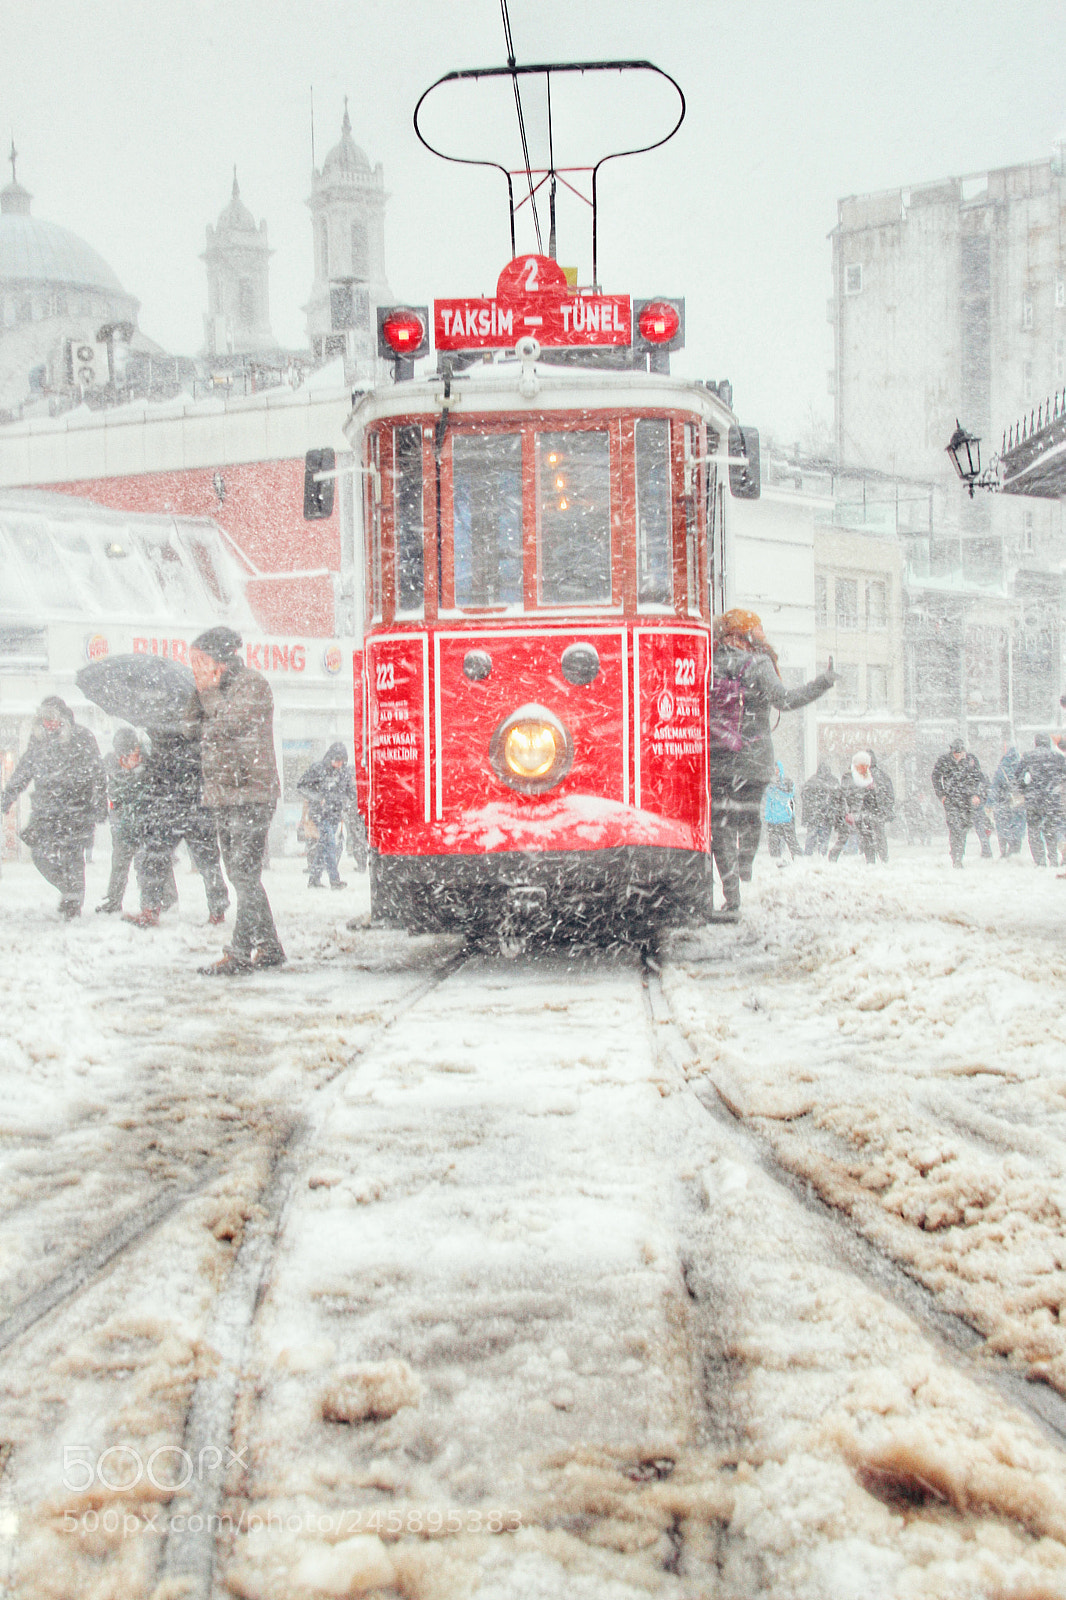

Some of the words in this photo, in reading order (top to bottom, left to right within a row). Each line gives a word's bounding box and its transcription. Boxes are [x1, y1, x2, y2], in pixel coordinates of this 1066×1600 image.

[525, 258, 539, 291] 2
[441, 302, 513, 336] TAKSİM
[560, 298, 625, 332] TÜNEL
[246, 643, 306, 672] KING
[675, 658, 695, 685] 223
[376, 663, 395, 691] 223
